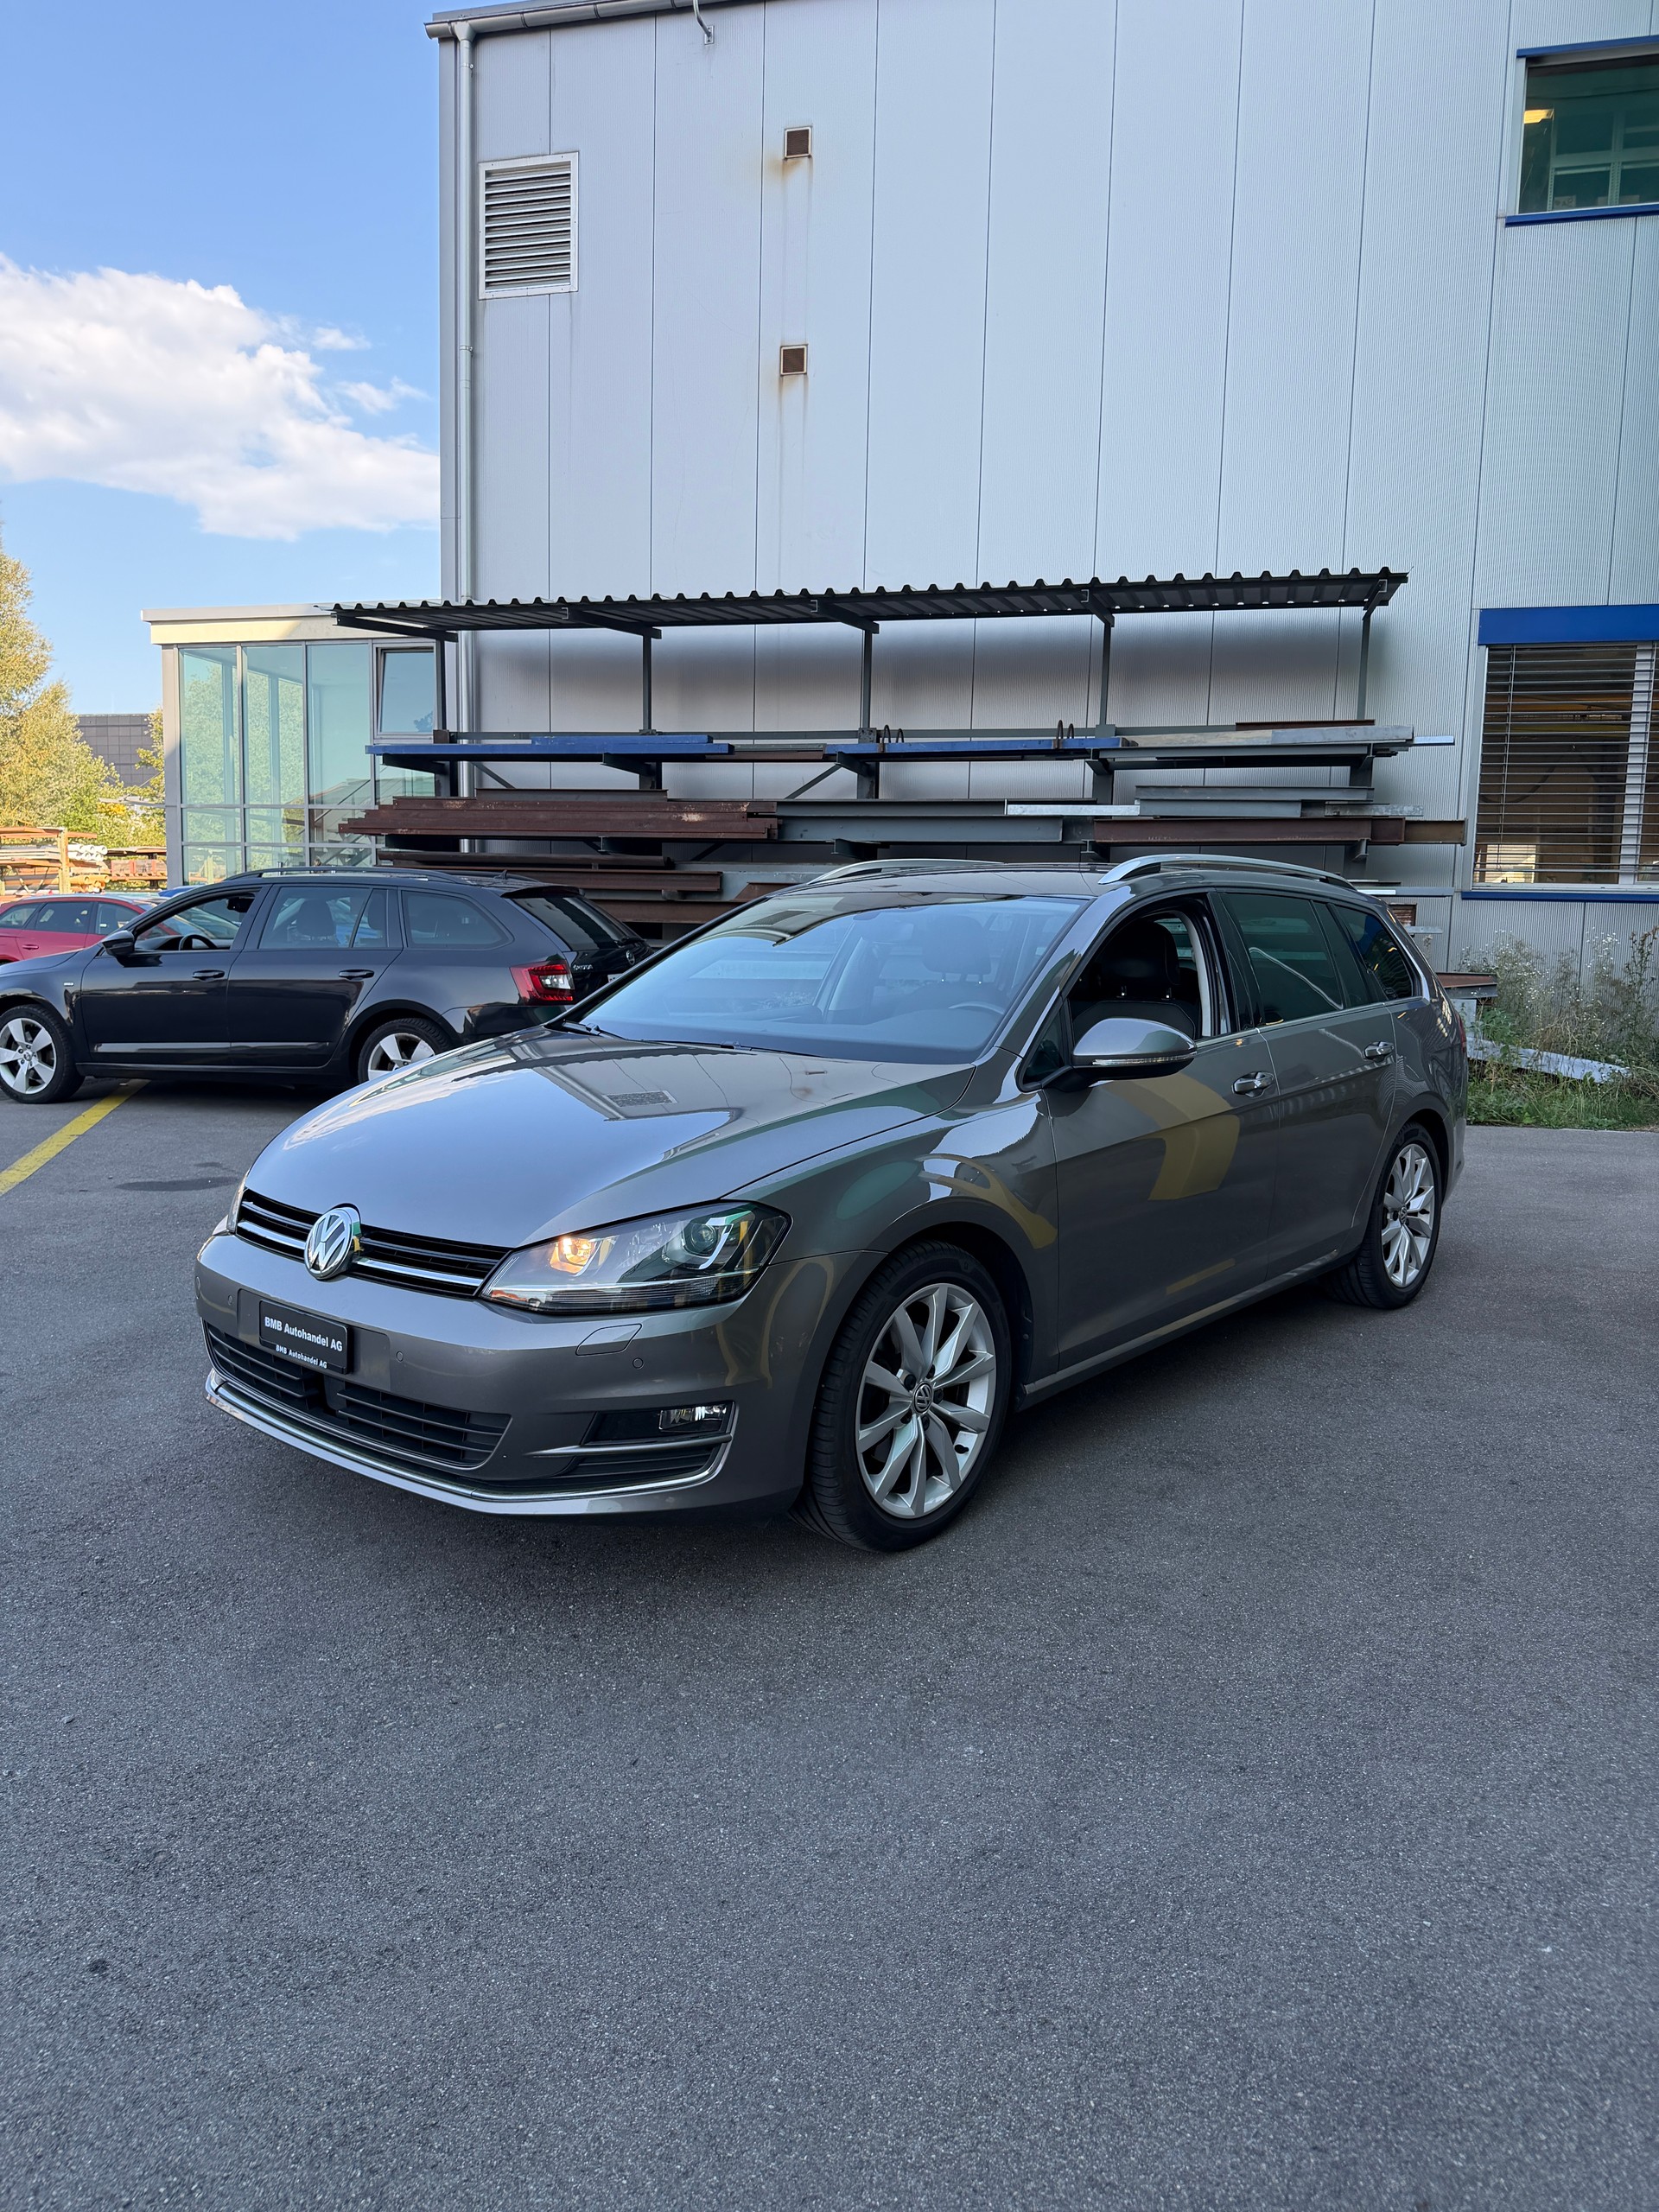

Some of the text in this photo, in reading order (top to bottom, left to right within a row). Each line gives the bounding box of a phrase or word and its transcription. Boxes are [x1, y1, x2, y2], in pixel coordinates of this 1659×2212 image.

[264, 1316, 343, 1351] BMB Autohandel AG
[276, 1344, 327, 1369] BMB Autohandel AG
